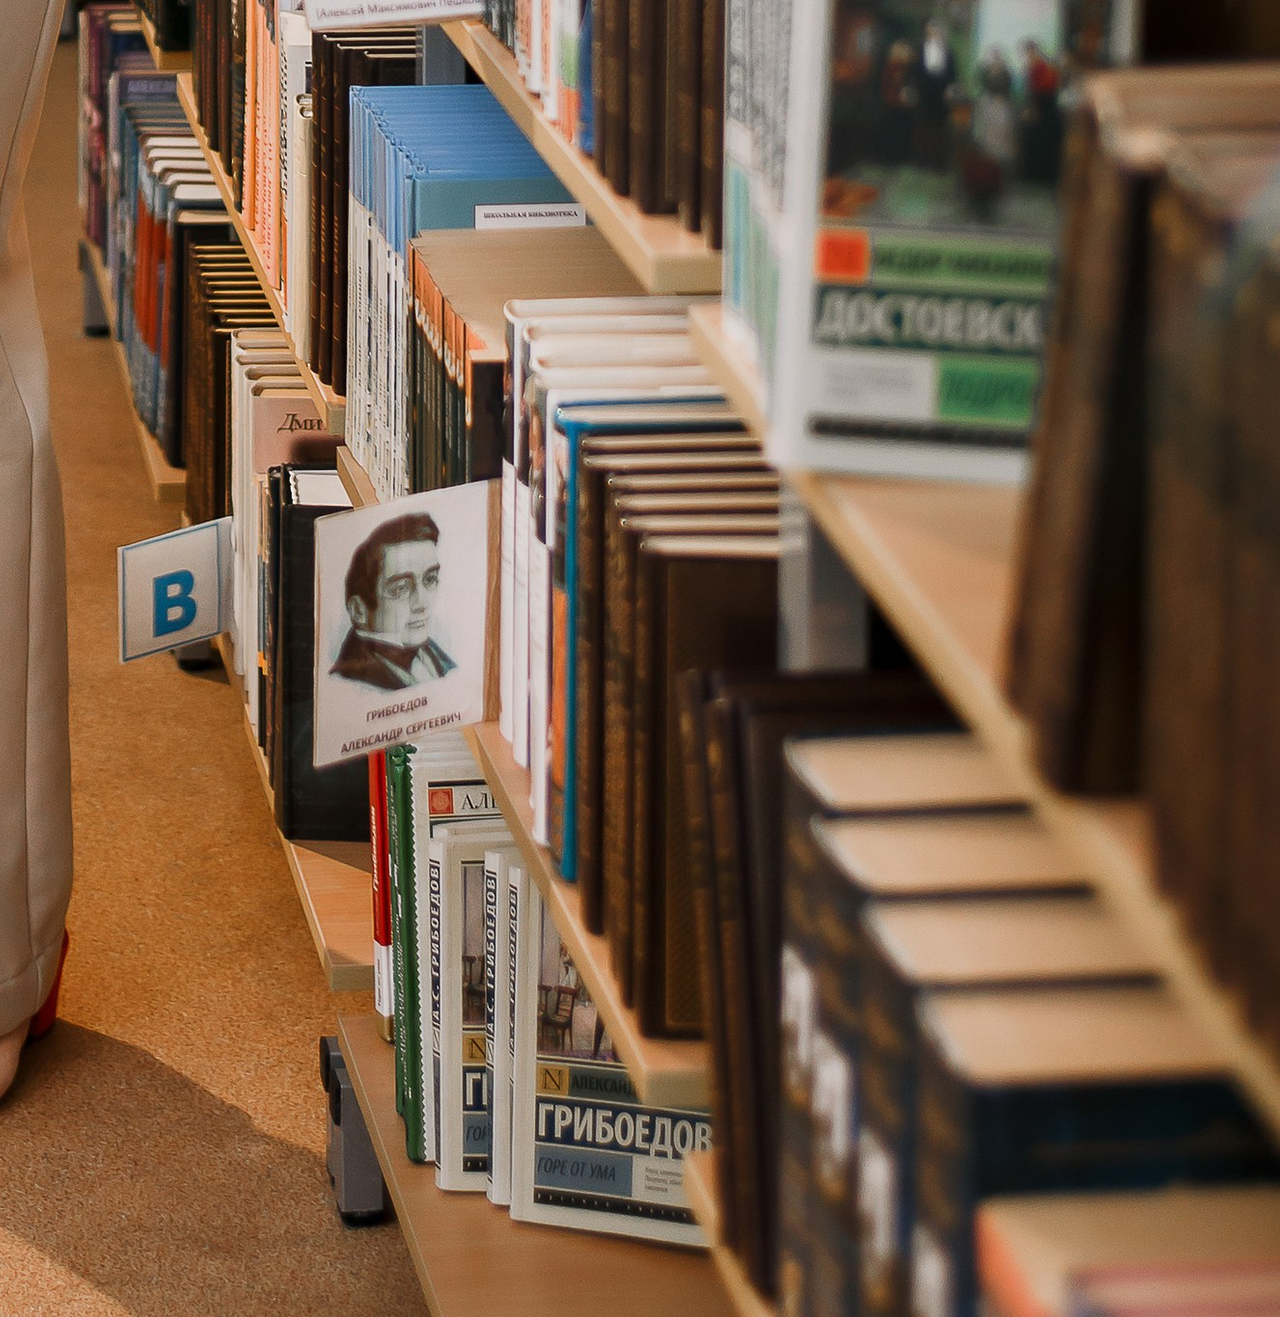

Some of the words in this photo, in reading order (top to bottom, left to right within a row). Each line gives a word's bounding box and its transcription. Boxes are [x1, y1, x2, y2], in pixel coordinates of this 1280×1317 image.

[277, 413, 326, 433] Дми
[153, 569, 197, 638] В
[340, 727, 403, 753] АЛЕКСАНДР
[405, 712, 461, 735] СЕРГЕЕВИЧ
[366, 696, 428, 722] ГРИБОЕДОВ
[429, 866, 440, 977] ГРИБОЕДОВ
[486, 877, 496, 989] ГРИБОЕДОВ
[509, 891, 517, 1003] ГРИБОЕДОВ
[538, 1103, 713, 1159] ГРИБОЕДОВ
[538, 1157, 567, 1176] ГОРЕ
[571, 1162, 587, 1177] ОТ
[590, 1165, 616, 1182] УМА
